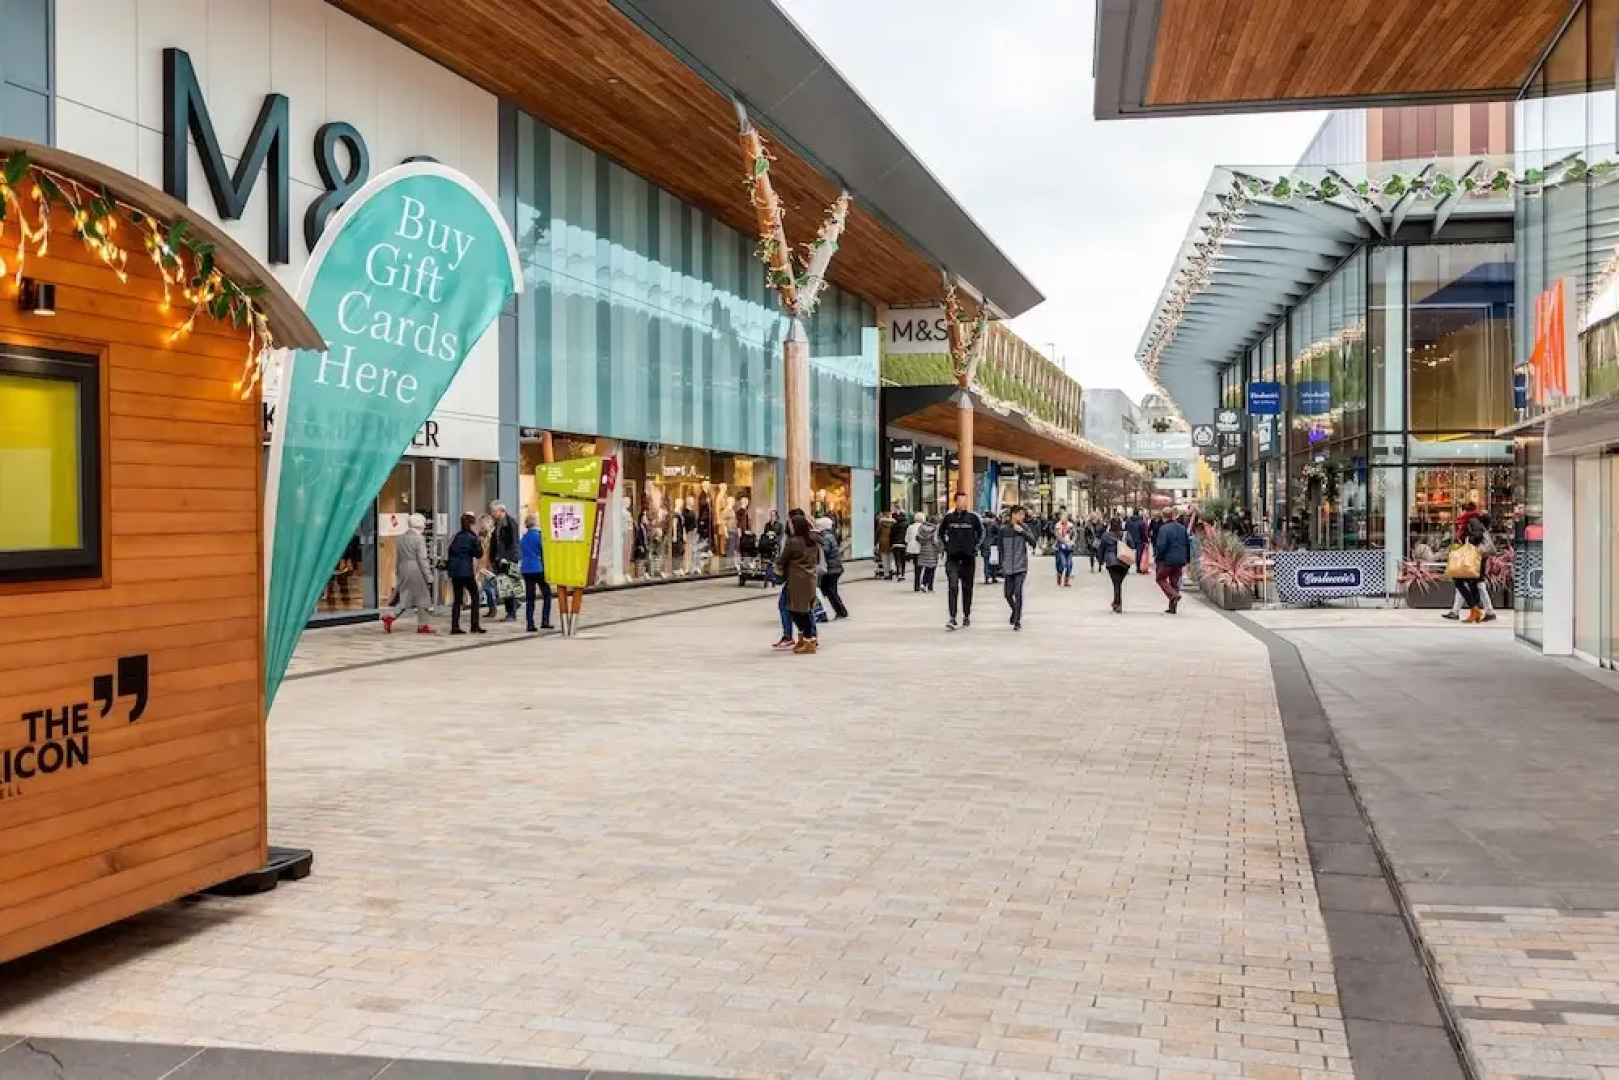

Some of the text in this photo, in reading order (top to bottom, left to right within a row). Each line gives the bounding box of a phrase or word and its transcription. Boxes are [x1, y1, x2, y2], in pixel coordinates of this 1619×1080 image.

[162, 46, 441, 265] M&
[395, 196, 475, 270] Buy
[365, 243, 445, 303] Gift
[337, 291, 457, 362] Cards
[892, 318, 949, 343] M&S
[313, 340, 419, 404] Here
[21, 702, 89, 743] THE
[0, 735, 89, 783] ICON
